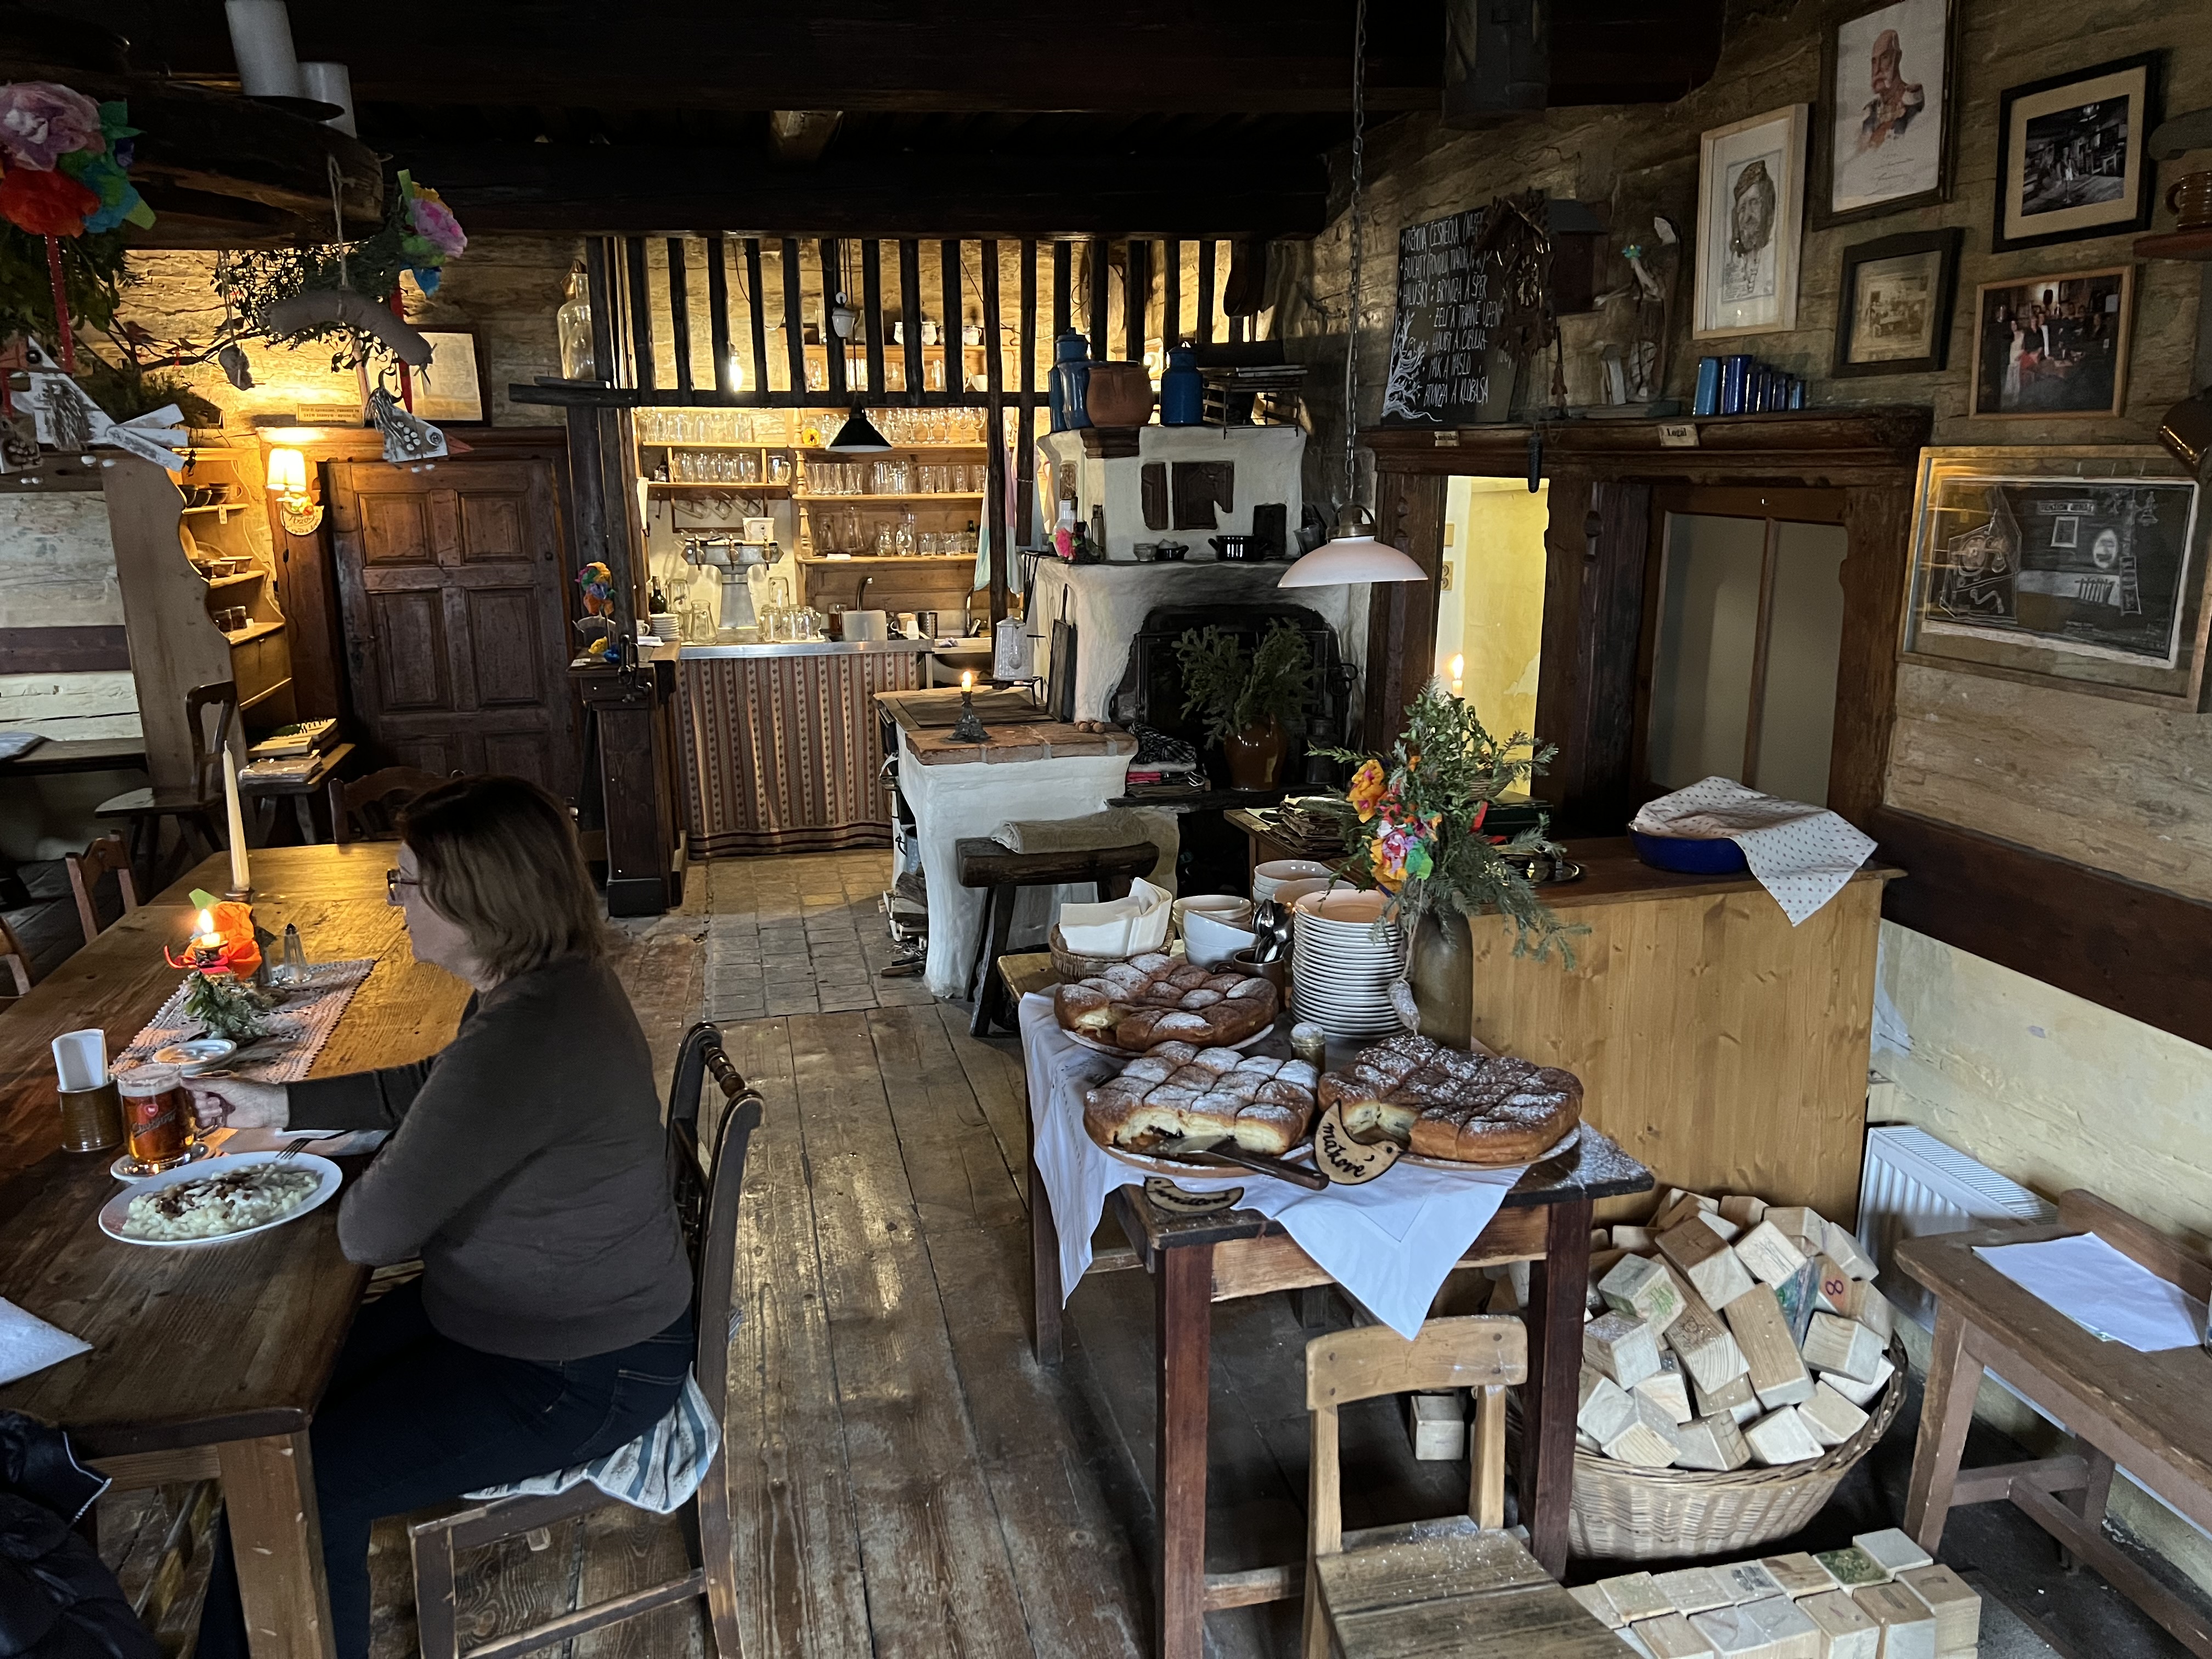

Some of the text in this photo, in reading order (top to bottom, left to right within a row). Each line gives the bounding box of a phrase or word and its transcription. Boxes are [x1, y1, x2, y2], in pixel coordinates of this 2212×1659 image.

[1404, 253, 1427, 280] BUCHTY
[1464, 274, 1470, 301] A
[1471, 272, 1488, 299] ŠPEK
[1450, 307, 1455, 328] A
[1431, 330, 1453, 353] HOUBY
[1453, 330, 1459, 352] A
[1443, 356, 1449, 380] A
[1451, 377, 1458, 404] A
[1323, 1122, 1375, 1177] makové
